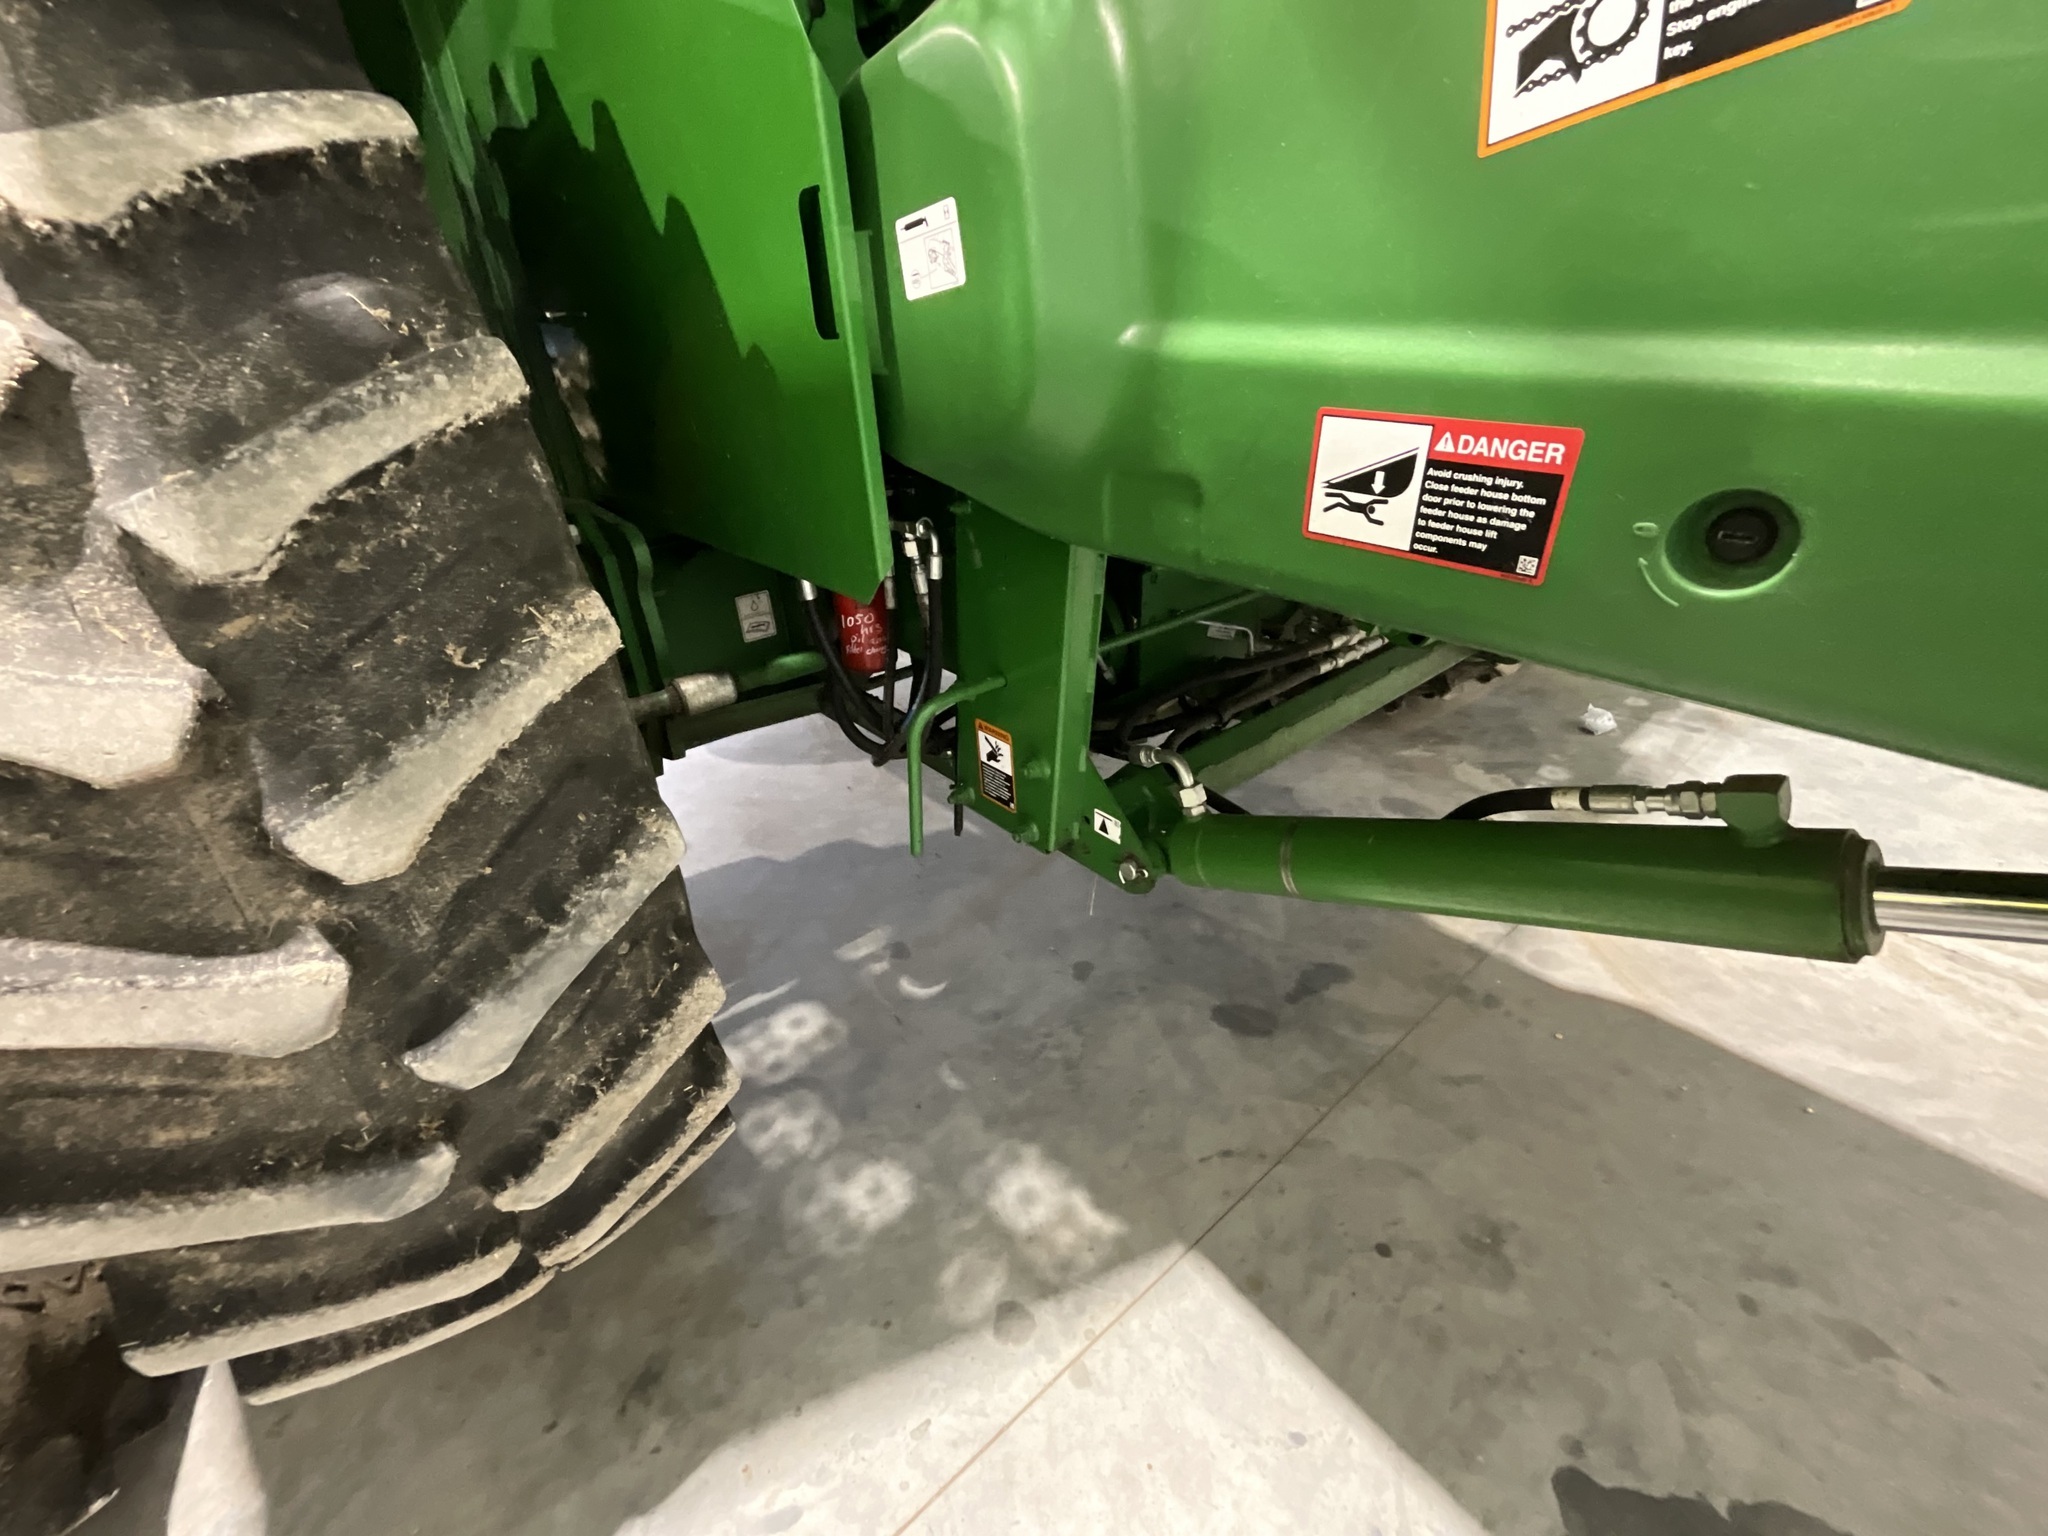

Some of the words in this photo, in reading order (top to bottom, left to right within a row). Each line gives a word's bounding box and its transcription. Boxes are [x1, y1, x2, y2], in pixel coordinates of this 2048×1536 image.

[1666, 14, 1703, 37] Stop
[1663, 40, 1694, 60] key.
[1457, 434, 1566, 465] DANGER
[1427, 467, 1452, 478] Avoid
[1453, 472, 1493, 486] crushing
[1495, 475, 1524, 489] injury.
[1424, 480, 1449, 491] Close
[1450, 483, 1479, 495] feeder
[1480, 488, 1509, 500] house
[1511, 492, 1546, 505] bottom
[1422, 493, 1442, 503] door
[1443, 497, 1465, 507] prior
[1466, 500, 1476, 509] to
[1477, 501, 1517, 517] lowering
[1519, 508, 1535, 518] the
[1417, 518, 1426, 526] to
[1427, 519, 1454, 531] feeder
[1455, 524, 1483, 536] house
[1484, 529, 1498, 539] lift
[1420, 505, 1446, 517] feeder
[1447, 510, 1475, 521] house
[1476, 516, 1487, 524] as
[1489, 517, 1527, 531] damage
[1412, 543, 1438, 553] occur.
[1415, 531, 1467, 546] components
[1468, 541, 1487, 552] may
[841, 612, 875, 629] 1050
